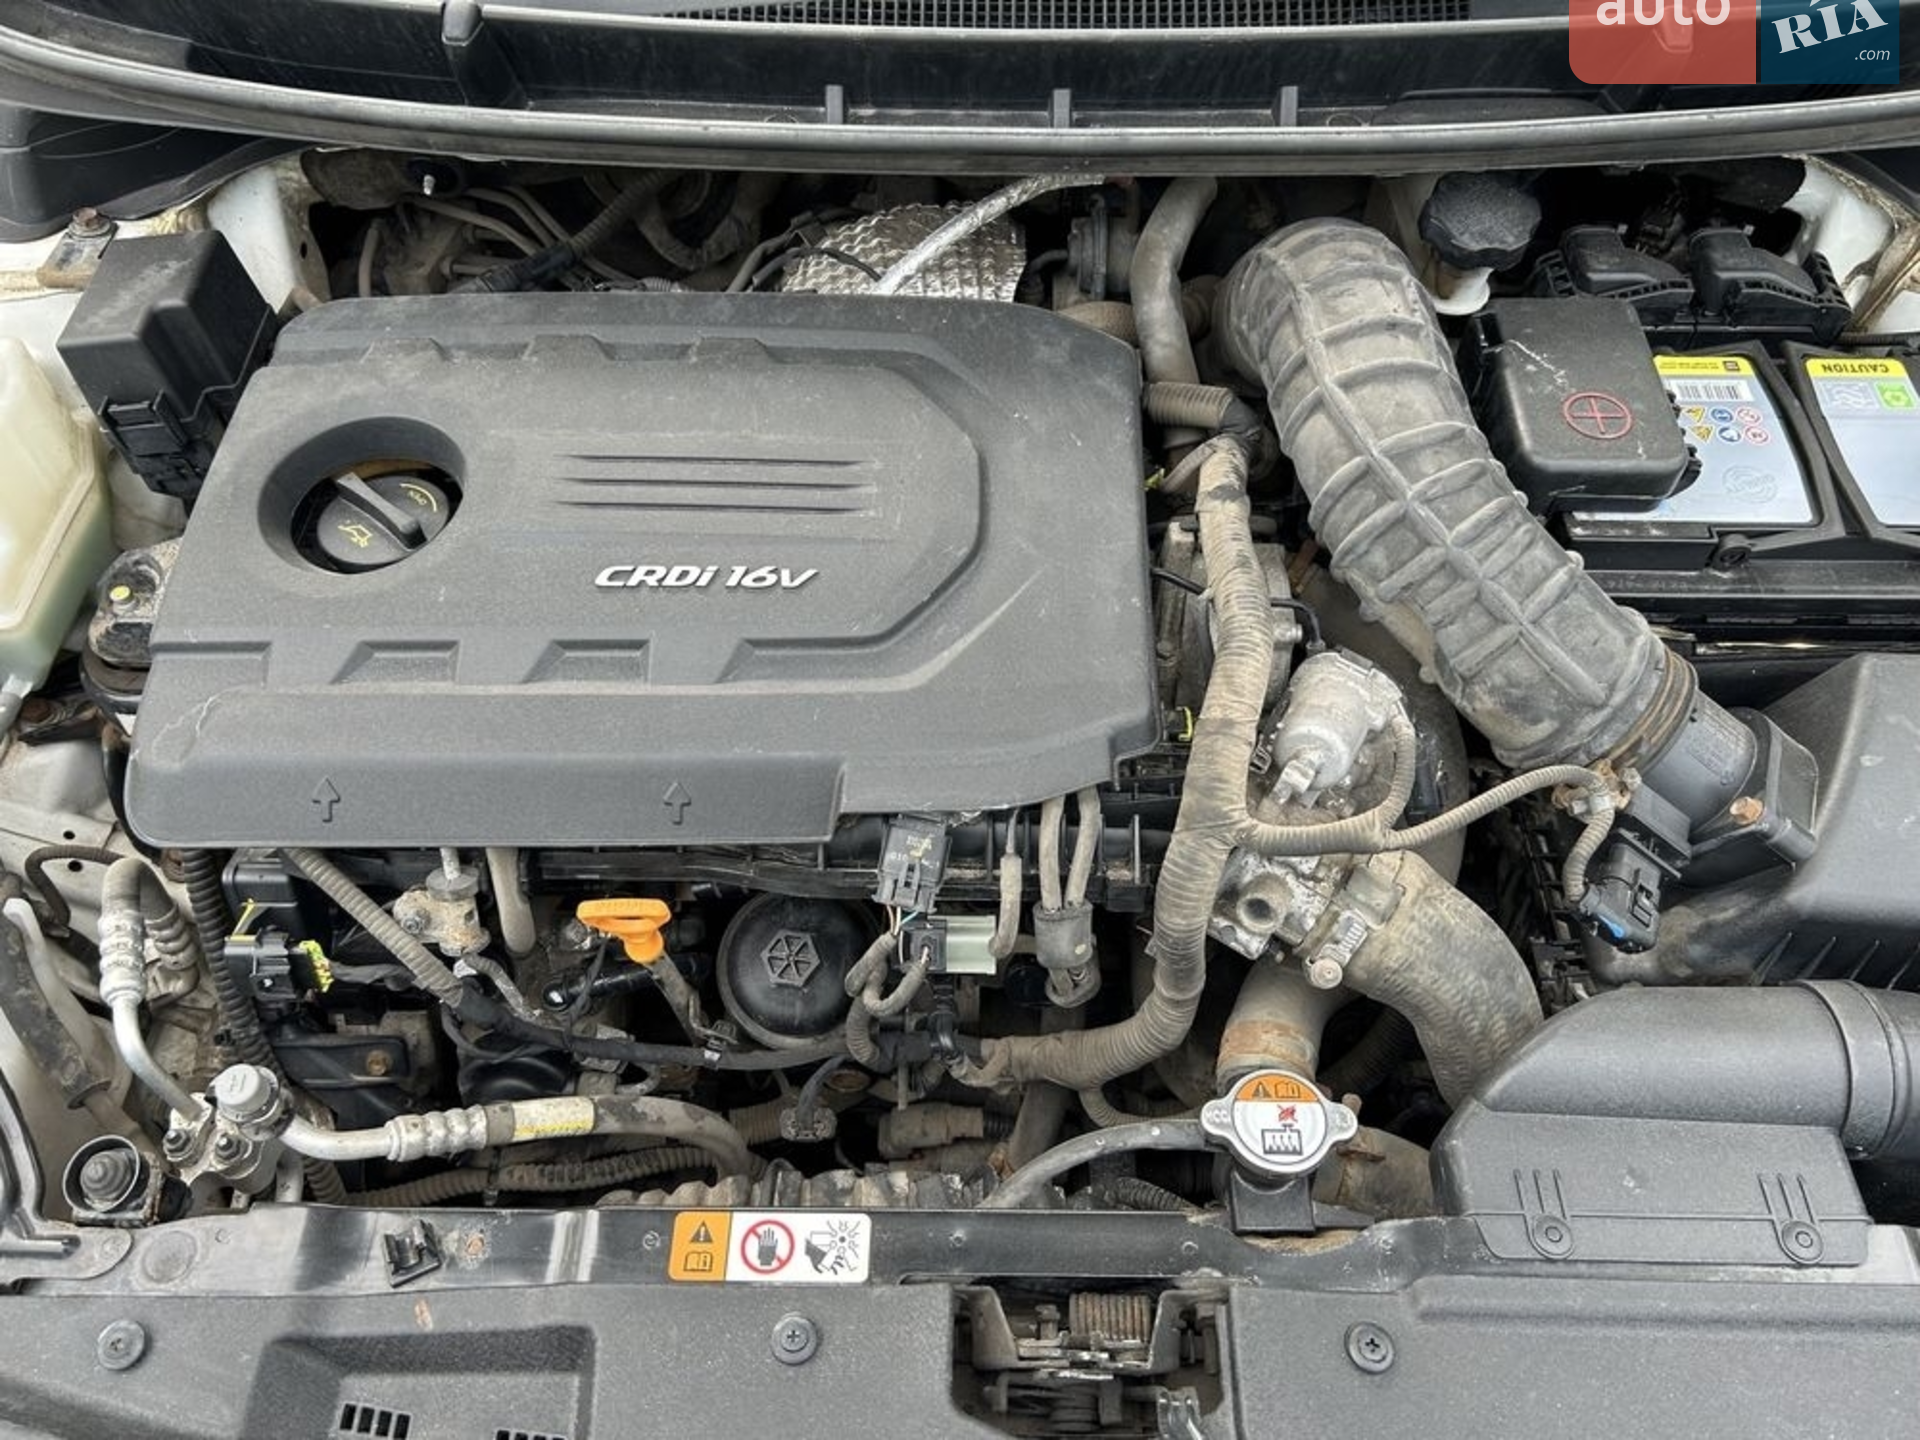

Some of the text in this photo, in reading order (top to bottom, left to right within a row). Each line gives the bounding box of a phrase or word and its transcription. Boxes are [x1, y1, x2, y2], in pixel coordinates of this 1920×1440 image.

[1821, 363, 1890, 375] CAUTION
[594, 565, 819, 589] CRDi 16V
